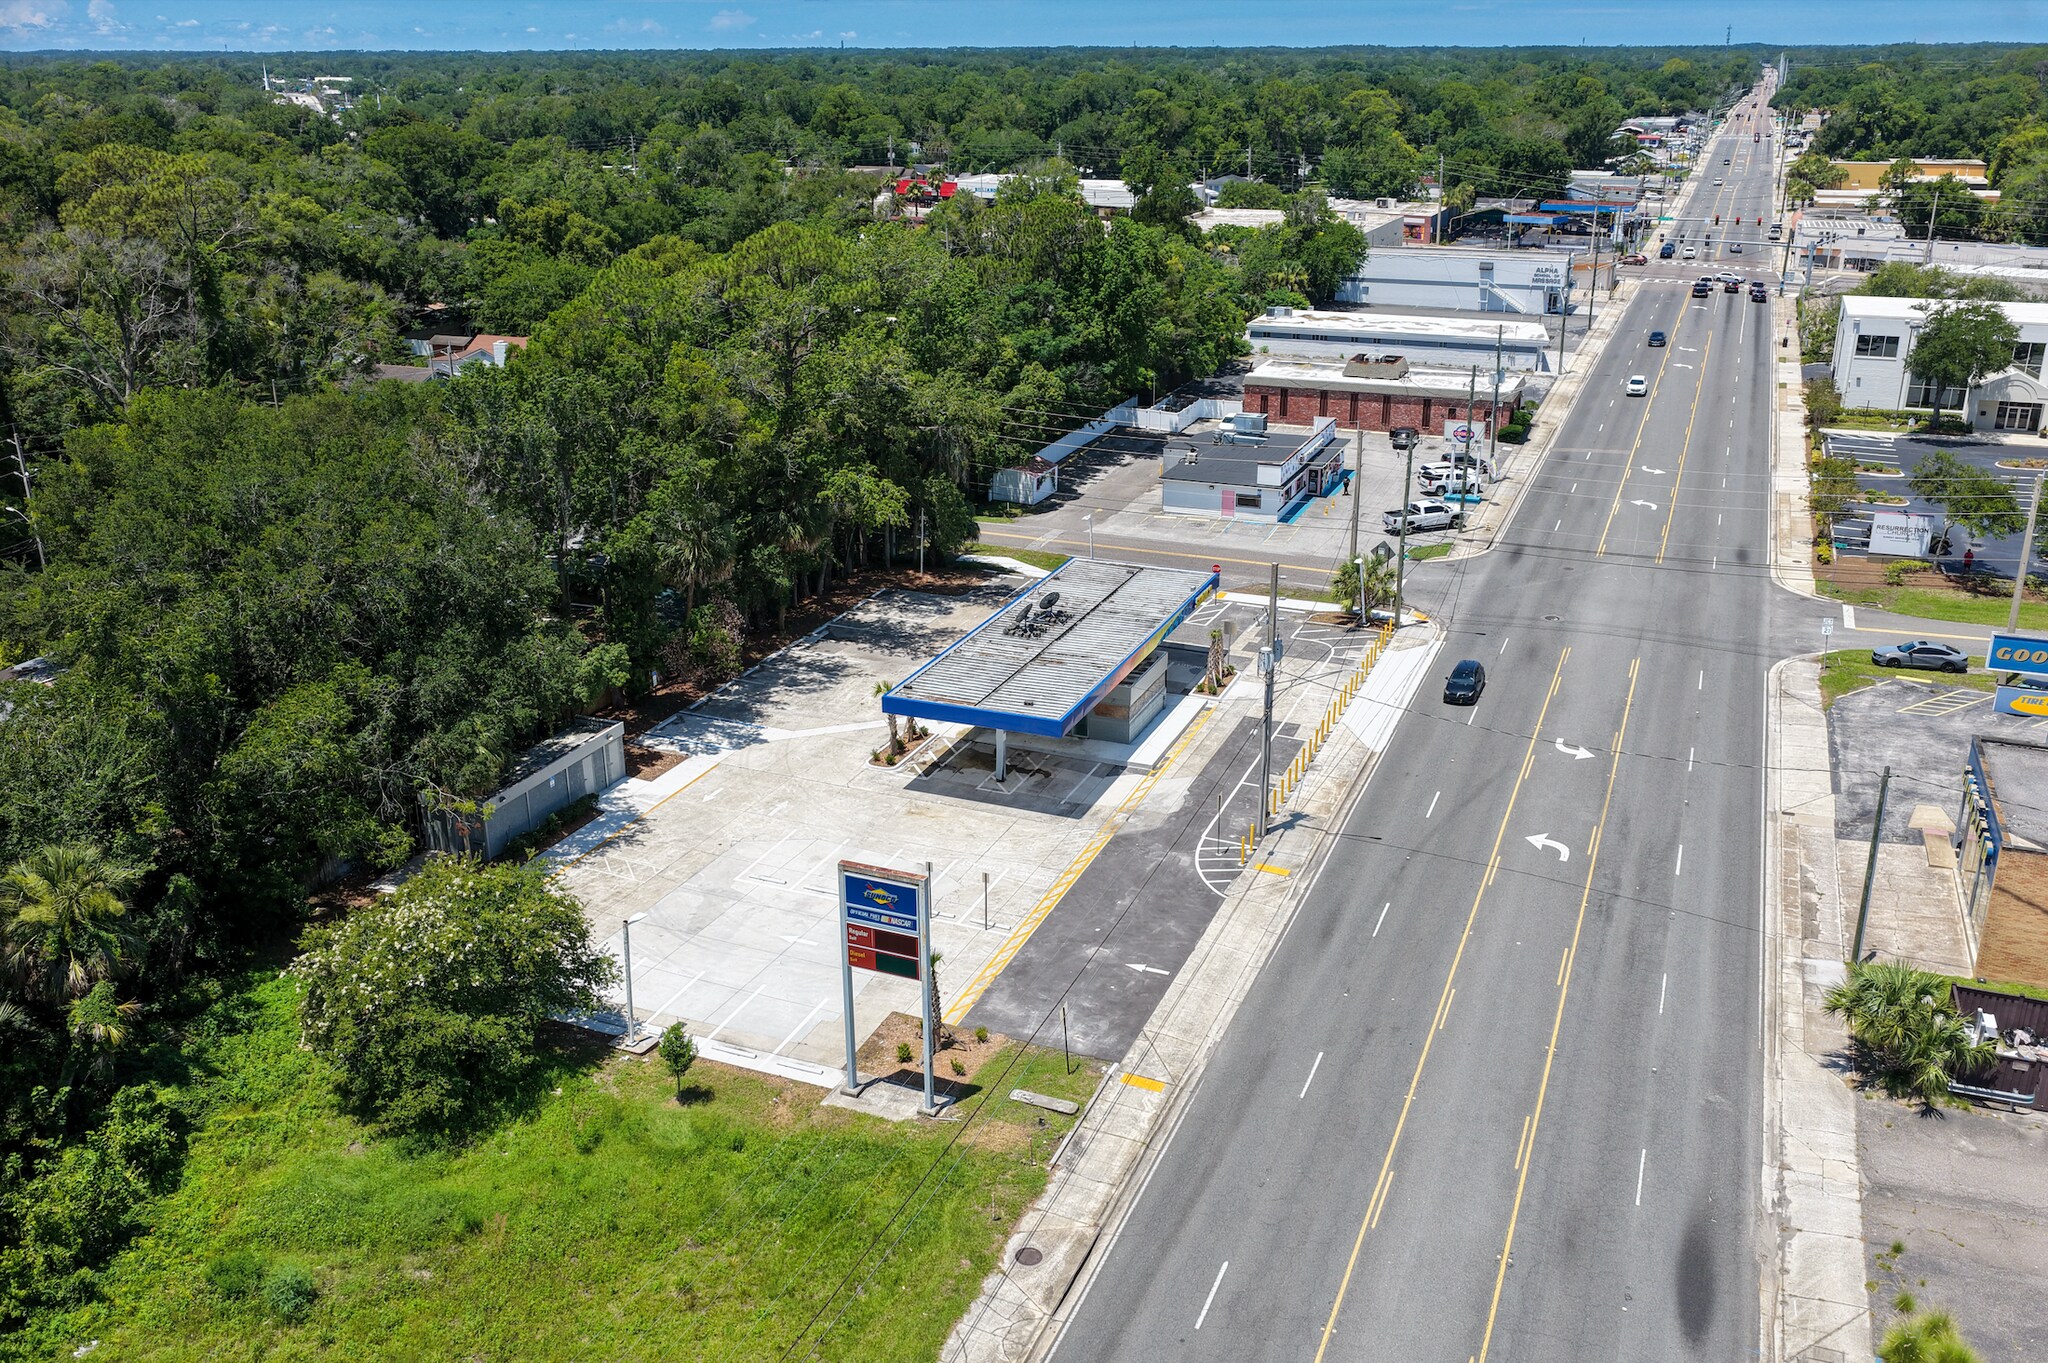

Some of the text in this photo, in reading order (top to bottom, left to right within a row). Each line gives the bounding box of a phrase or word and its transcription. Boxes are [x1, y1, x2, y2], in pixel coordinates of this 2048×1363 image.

[1876, 524, 1930, 534] RESURRECTION
[2021, 696, 2045, 706] TIRE
[865, 890, 898, 902] SUNOCO
[849, 908, 870, 918] OFFICIAL
[891, 917, 912, 927] NASCAR
[848, 928, 868, 936] Regular
[849, 949, 866, 958] Diesel
